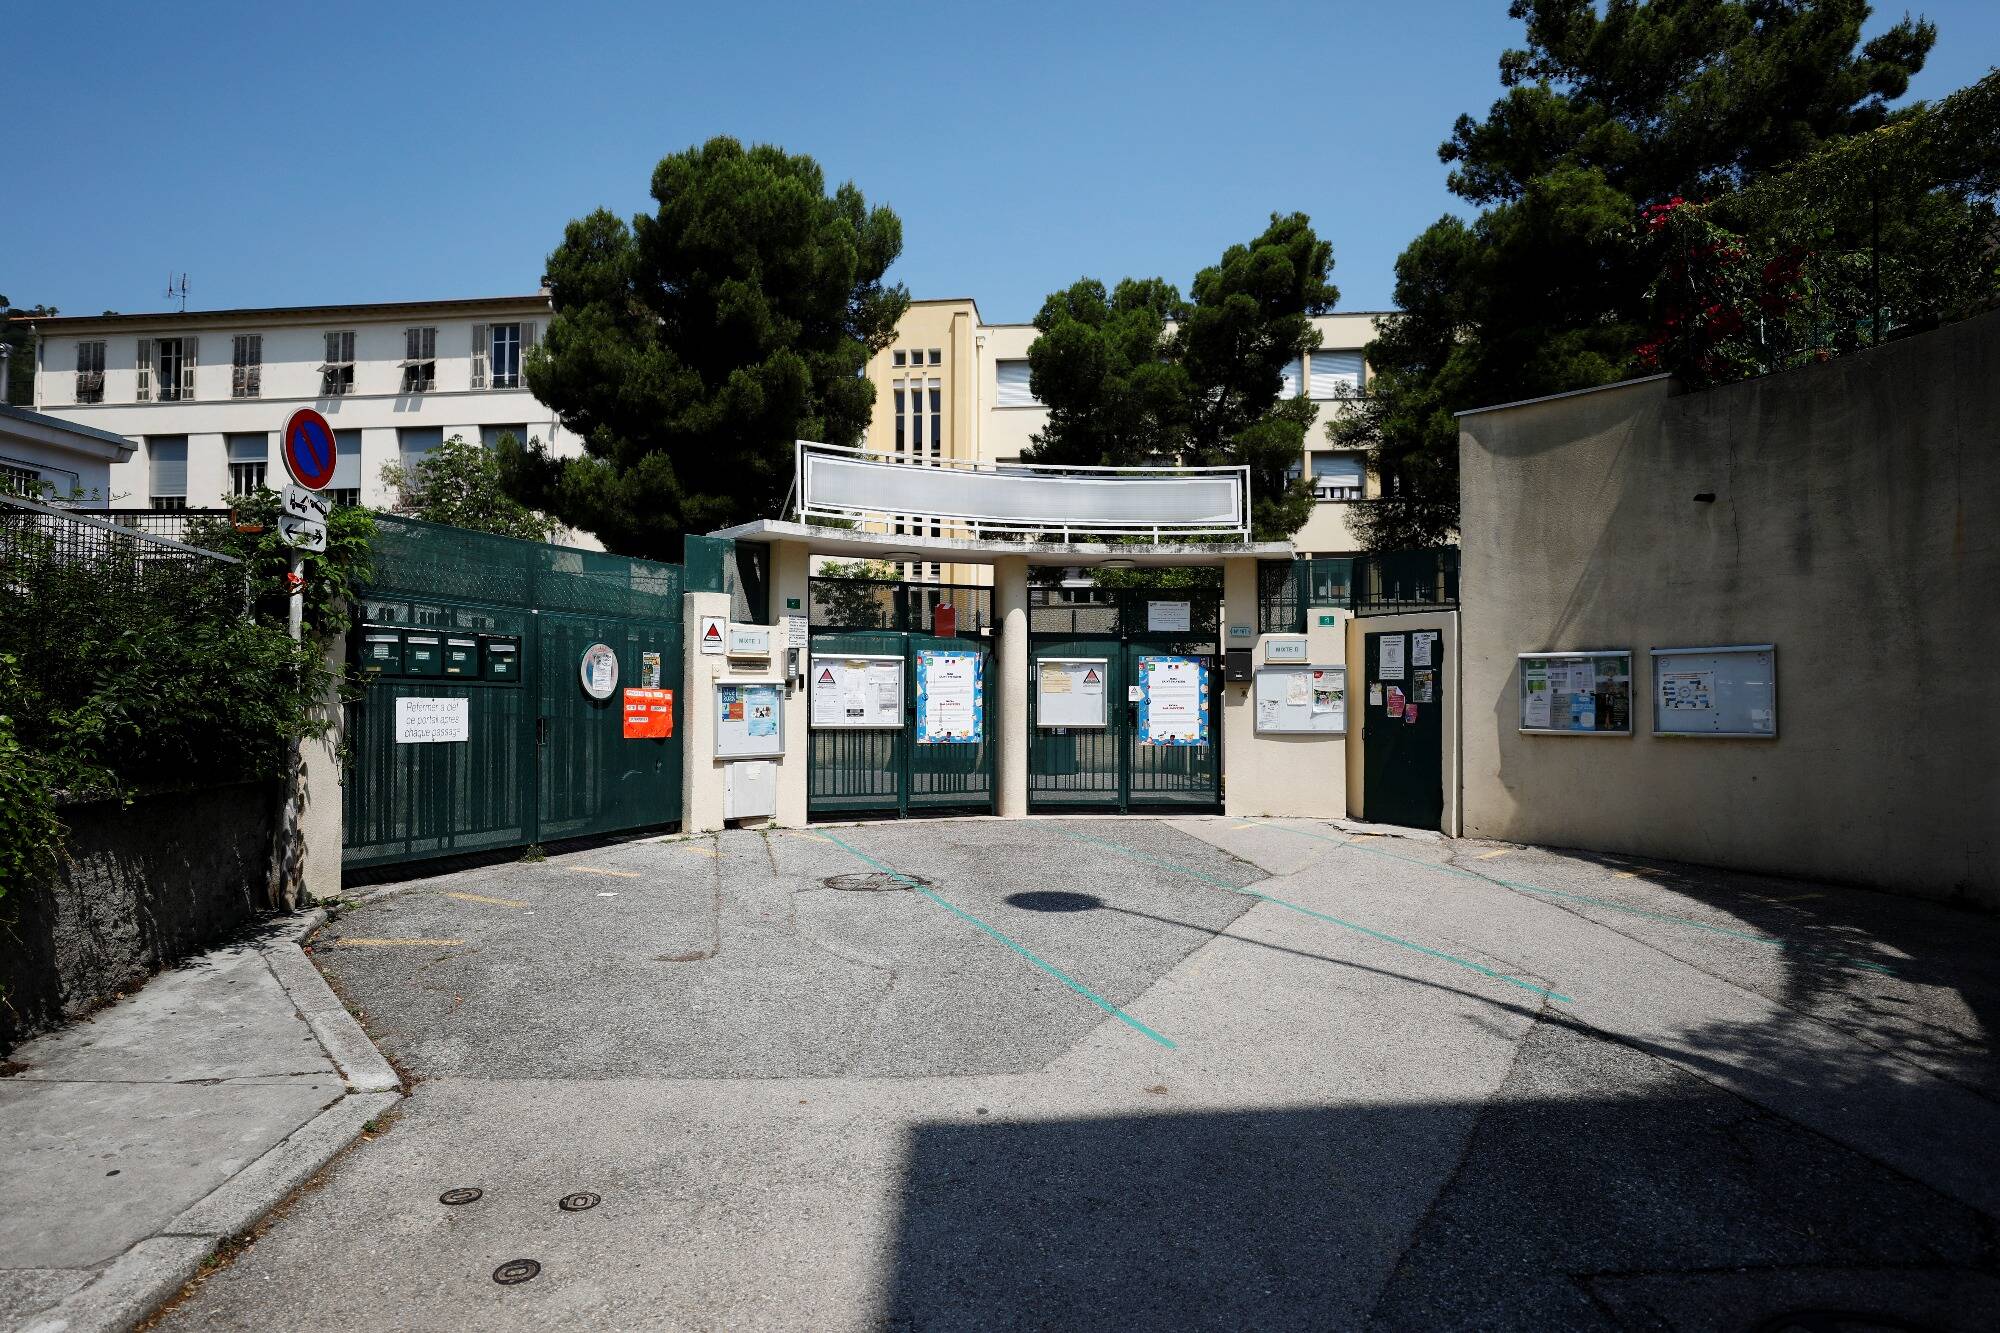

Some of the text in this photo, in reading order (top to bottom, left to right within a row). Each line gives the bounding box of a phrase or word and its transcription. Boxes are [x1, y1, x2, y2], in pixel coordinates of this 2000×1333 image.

[406, 702, 439, 712] Refermer
[417, 715, 438, 726] portail
[404, 728, 431, 738] chaque
